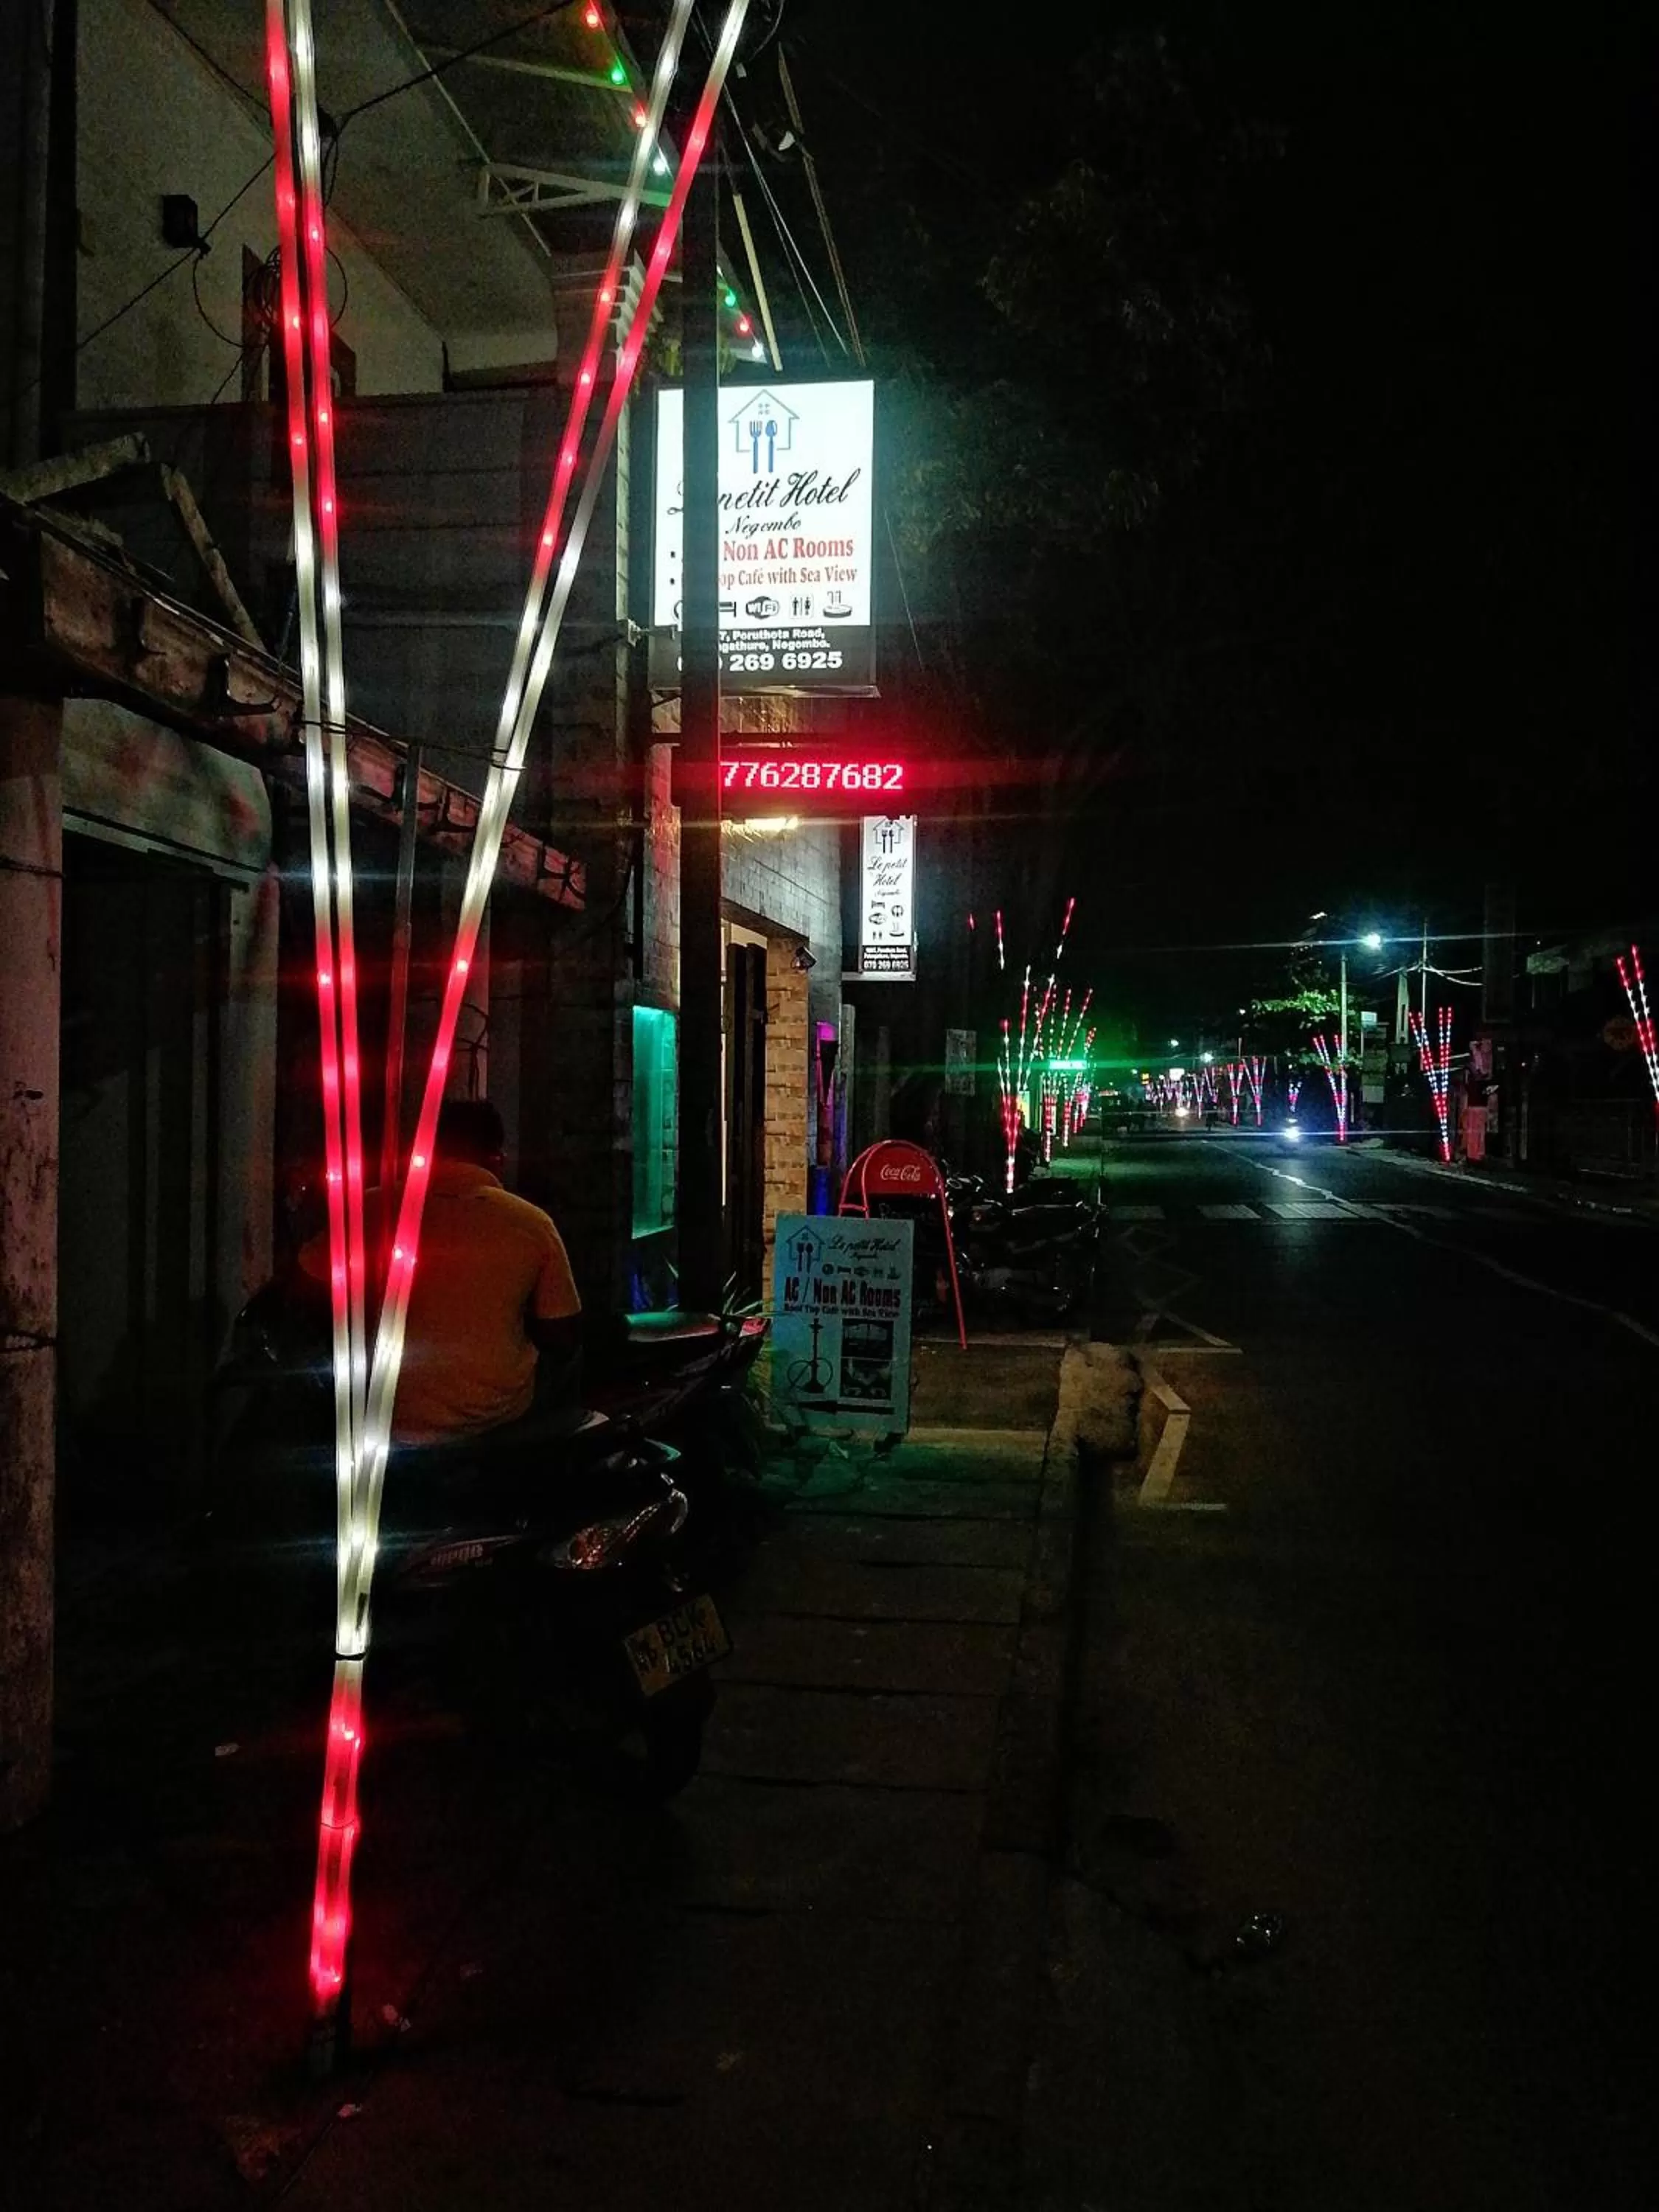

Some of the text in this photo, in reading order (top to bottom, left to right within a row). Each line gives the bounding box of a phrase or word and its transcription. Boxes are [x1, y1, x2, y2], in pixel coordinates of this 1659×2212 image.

[779, 467, 861, 508] Hotel
[725, 511, 801, 539] Negombo
[723, 537, 854, 561] Non AC Rooms
[719, 571, 735, 591] op
[768, 567, 797, 584] with
[800, 567, 821, 582] Sea
[824, 564, 858, 582] View
[729, 653, 775, 672] 269
[781, 651, 843, 670] 6925
[873, 873, 902, 887] Hotel
[785, 1276, 800, 1301] AC
[813, 1277, 838, 1304] Non
[841, 1279, 856, 1304] AC
[860, 1281, 901, 1308] Rooms
